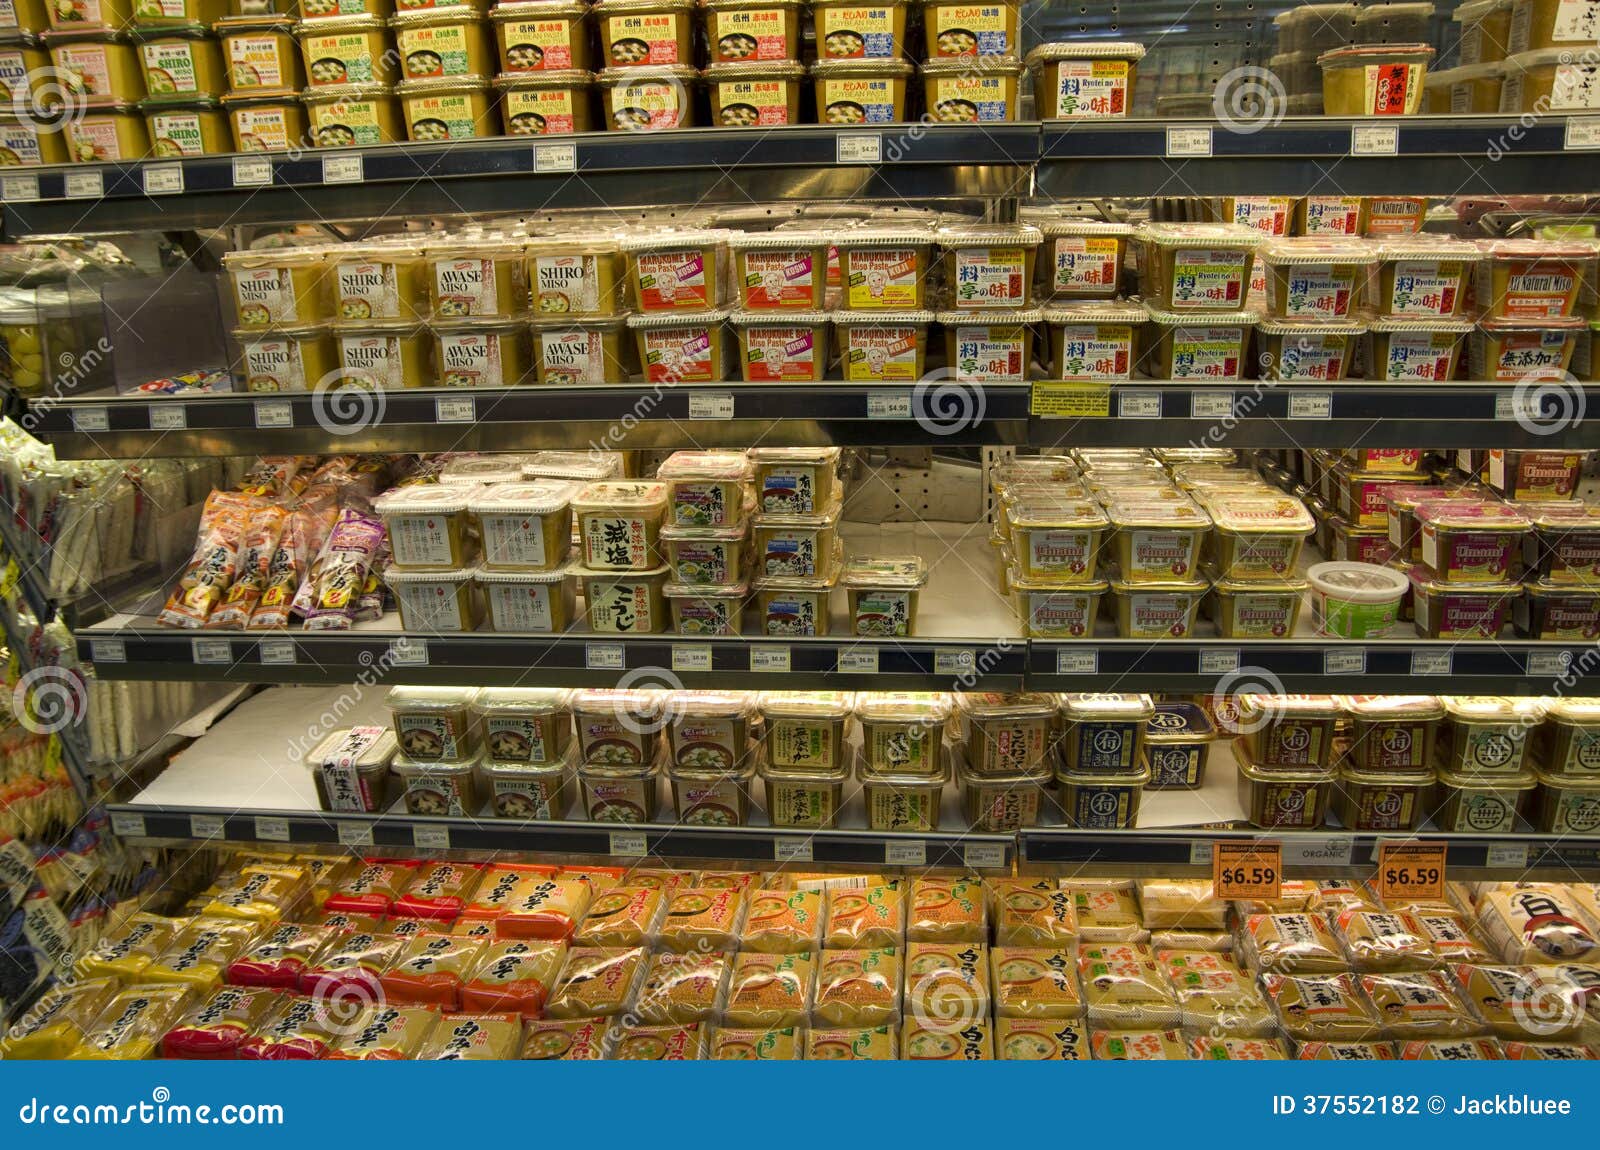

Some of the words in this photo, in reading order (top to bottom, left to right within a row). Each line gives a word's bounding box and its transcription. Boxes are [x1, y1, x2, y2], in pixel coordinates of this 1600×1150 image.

[158, 58, 191, 69] SHIRO
[1082, 79, 1104, 88] Ryotei
[167, 130, 199, 141] SHIRO
[747, 252, 793, 263] MARUKOME
[851, 252, 896, 262] MARUKOME
[1077, 254, 1097, 262] Ryotei
[851, 262, 868, 271] Miso
[869, 262, 889, 271] Paste
[981, 265, 1002, 274] Ryotei
[441, 270, 482, 283] AWASE
[540, 267, 583, 279] SHIRO
[1198, 272, 1221, 280] Ryotei
[341, 274, 384, 286] SHIRO
[541, 279, 568, 289] MISO
[1309, 281, 1330, 289] Ryotei
[1416, 279, 1437, 287] Ryotei
[1522, 275, 1550, 291] Natural
[1552, 276, 1571, 290] Miso
[240, 279, 281, 292] SHIRO
[440, 283, 468, 293] MISO
[241, 291, 267, 300] MISO
[342, 286, 369, 296] MISO
[750, 329, 794, 339] MARUKOME
[851, 329, 896, 339] MARUKOME
[546, 343, 588, 355] AWASE
[981, 343, 1002, 352] Ryotei
[1088, 342, 1108, 350] Ryotei
[346, 347, 388, 360] SHIRO
[446, 345, 487, 358] AWASE
[250, 352, 290, 364] SHIRO
[446, 357, 473, 367] MISO
[546, 355, 574, 365] MISO
[1502, 351, 1550, 368] 無添加
[251, 364, 277, 373] MISO
[347, 359, 374, 368] MISO
[604, 519, 632, 566] 減塩
[611, 585, 635, 631] こうじ
[1302, 850, 1345, 859] ORGANIC
[1222, 868, 1275, 888] $6.59
[1386, 868, 1439, 889] $6.59
